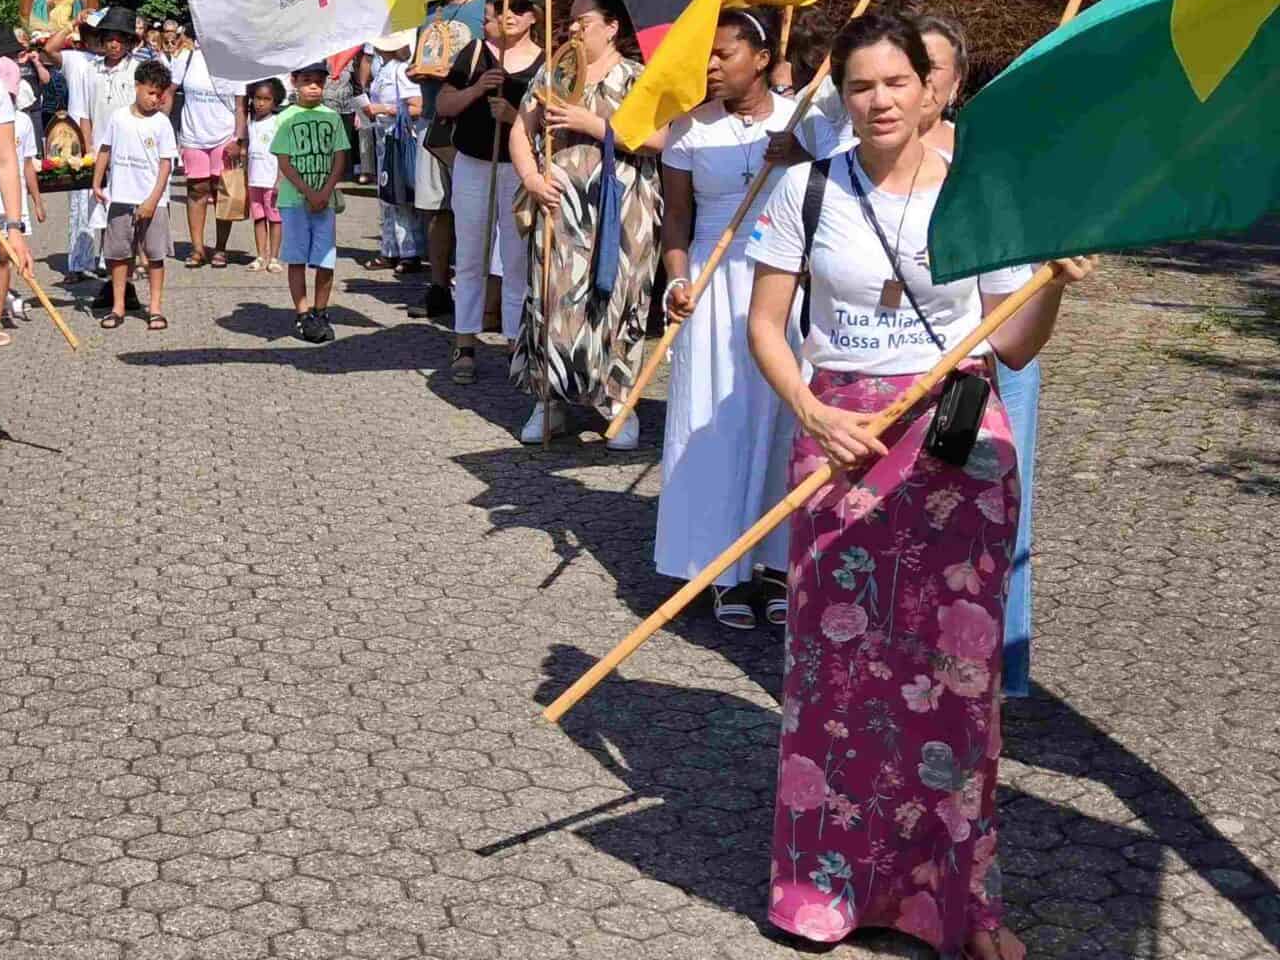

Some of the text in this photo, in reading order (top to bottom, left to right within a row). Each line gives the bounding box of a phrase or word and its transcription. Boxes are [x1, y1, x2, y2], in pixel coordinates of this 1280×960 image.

[292, 120, 333, 155] BIG
[835, 310, 870, 327] Tua
[830, 329, 881, 349] Nossa
